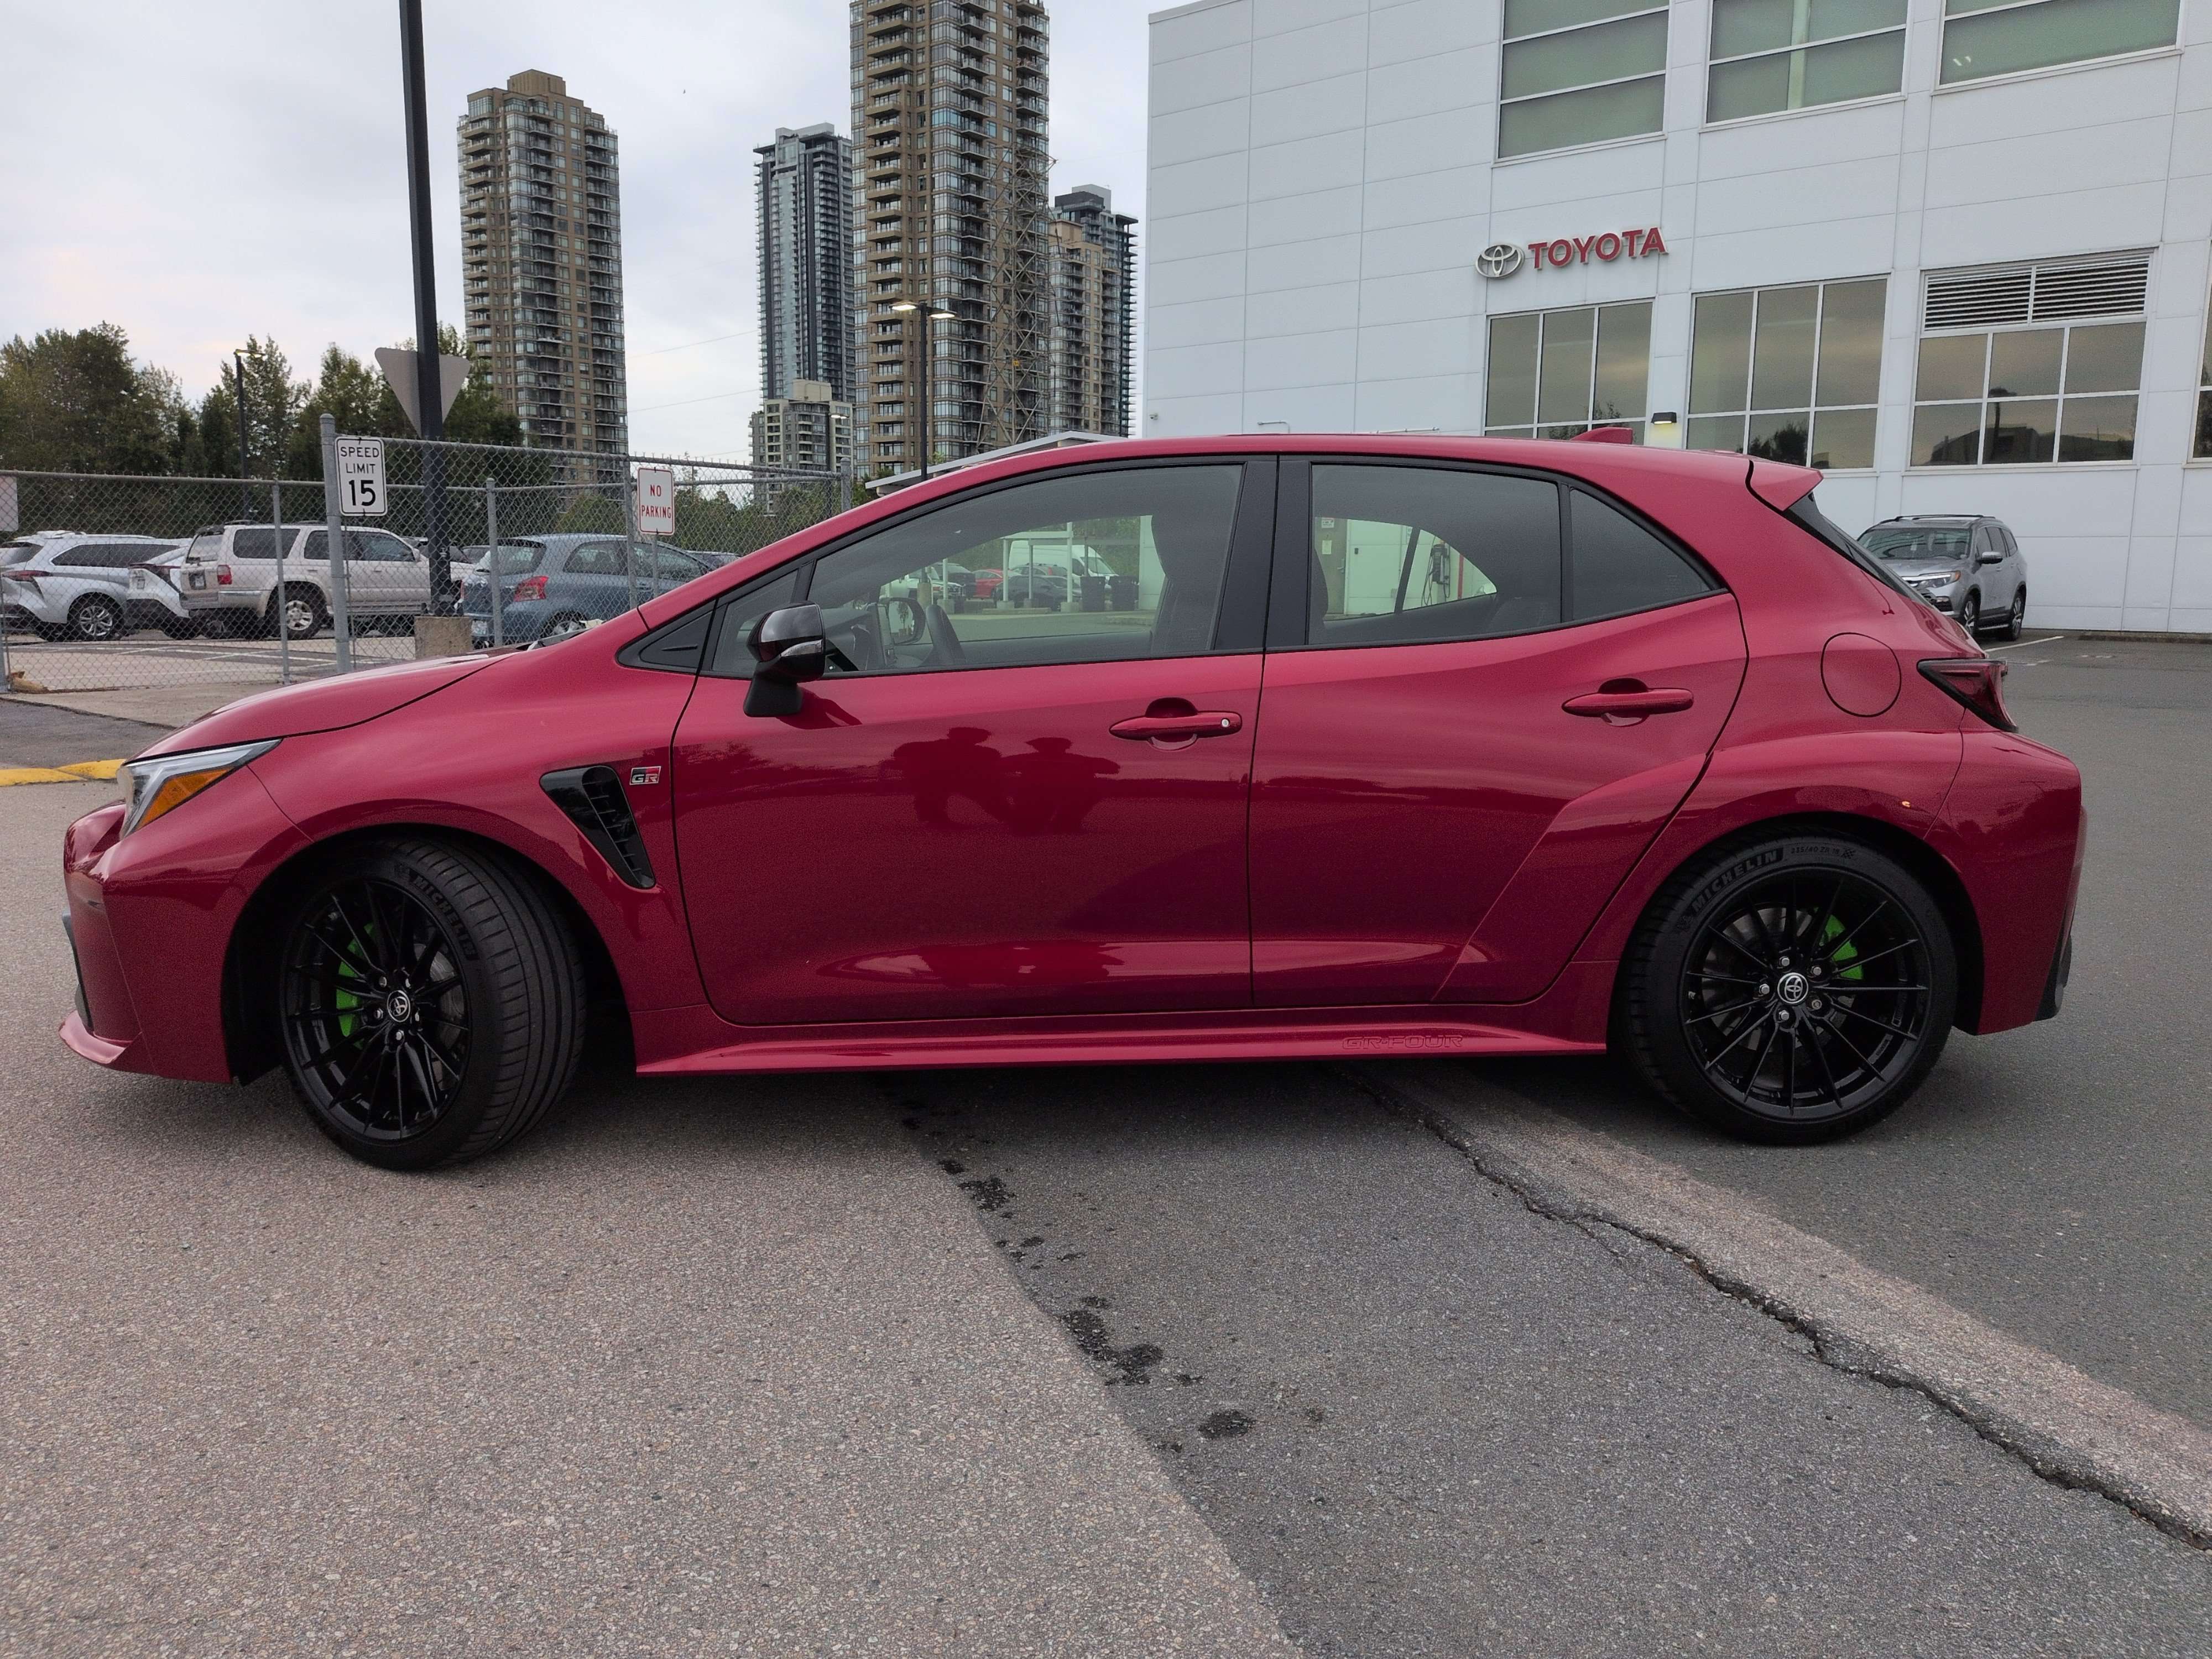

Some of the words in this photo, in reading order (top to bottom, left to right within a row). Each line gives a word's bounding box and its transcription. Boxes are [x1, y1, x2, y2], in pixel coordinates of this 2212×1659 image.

[1528, 227, 1668, 269] TOYOTA
[341, 447, 379, 457] SPEED
[346, 463, 375, 474] LIMIT
[349, 479, 376, 506] 15
[650, 484, 661, 497] NO
[641, 505, 671, 519] PARKING
[632, 774, 658, 783] GR
[1691, 848, 1779, 912] MICHELIN
[413, 875, 478, 956] MICHELIN
[1343, 1035, 1463, 1050] GR-FOUR
